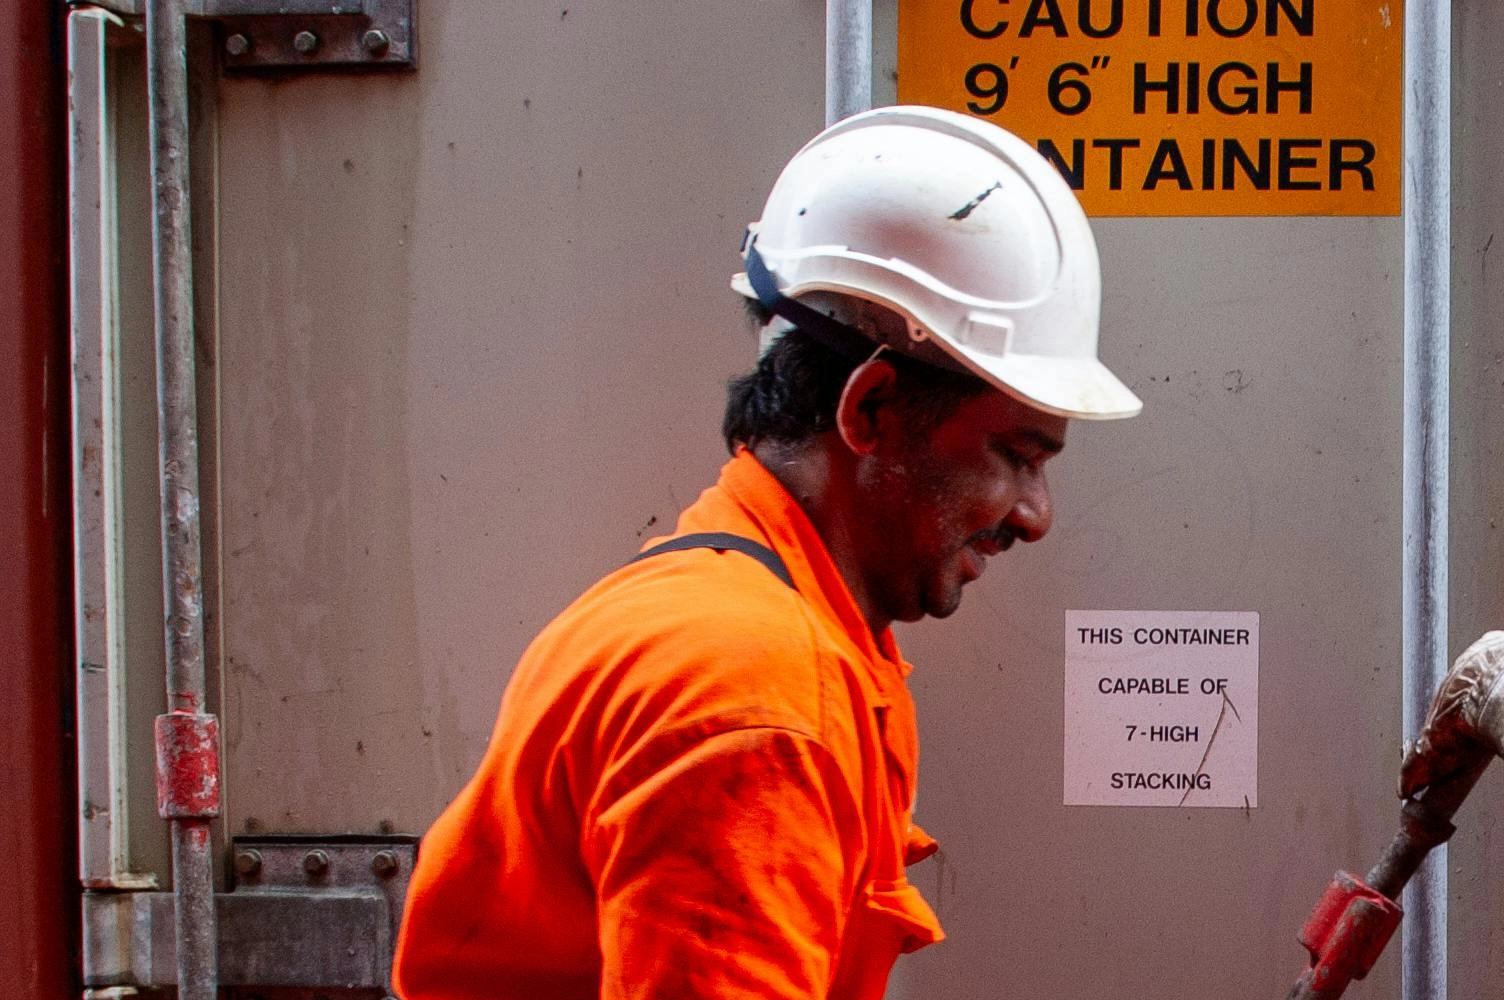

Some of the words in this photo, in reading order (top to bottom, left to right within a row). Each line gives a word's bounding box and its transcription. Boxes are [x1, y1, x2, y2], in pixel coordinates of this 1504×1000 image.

[1133, 62, 1313, 115] HIGH
[1037, 139, 1377, 191] NTAINER
[1077, 628, 1123, 645] THIS
[1134, 628, 1250, 646] CONTAINER
[1098, 677, 1190, 695] CAPABLE
[1200, 678, 1229, 695] OF
[1110, 773, 1212, 791] STACKING
